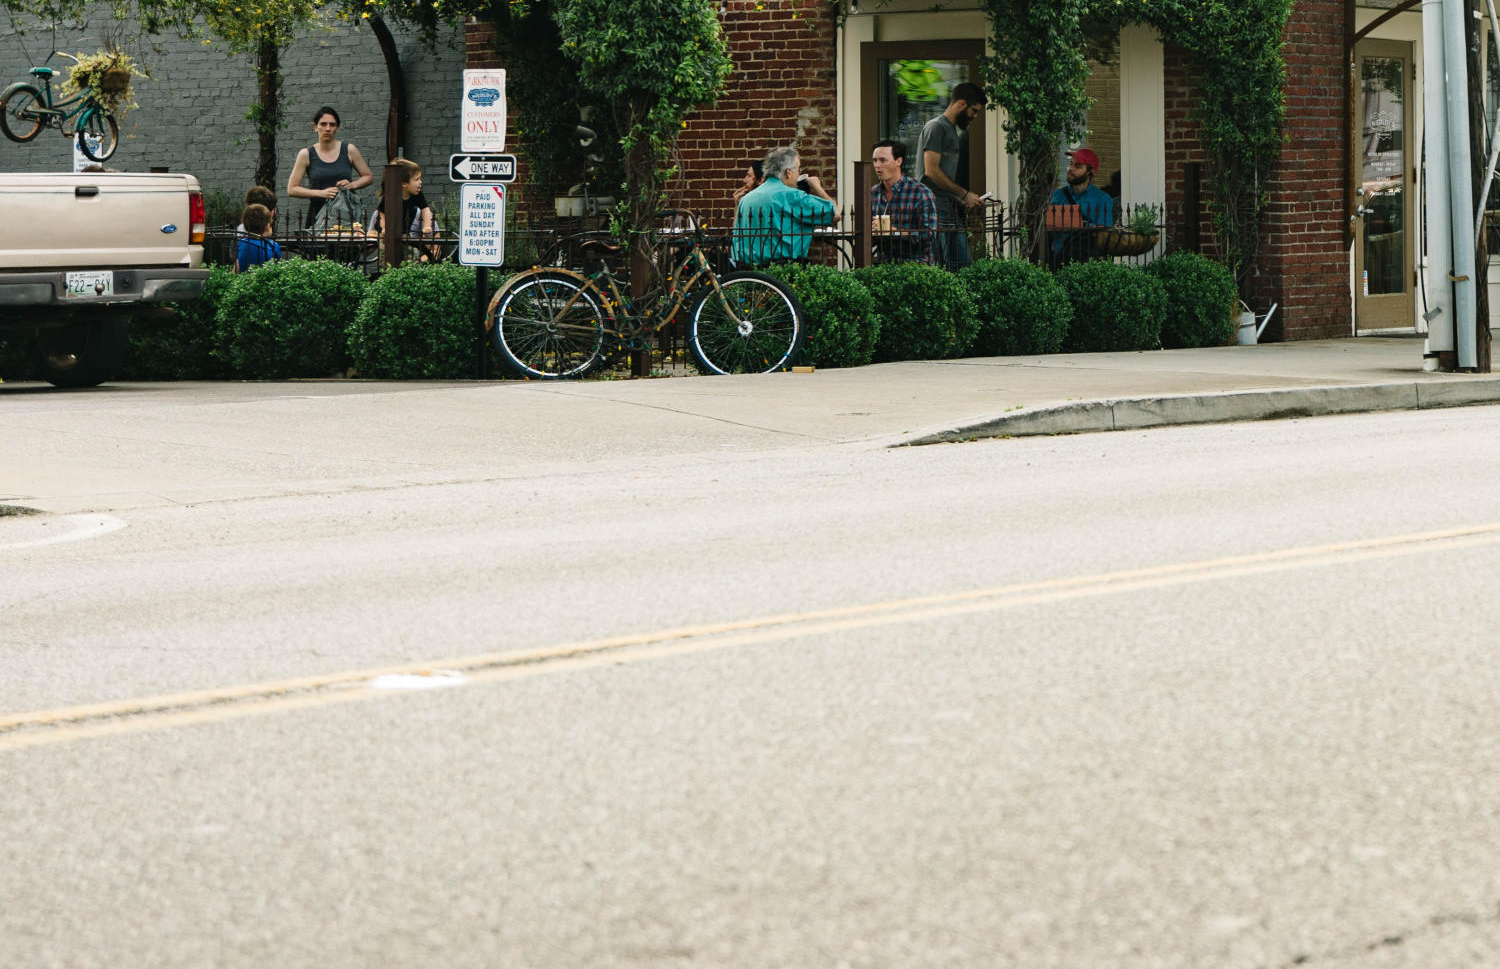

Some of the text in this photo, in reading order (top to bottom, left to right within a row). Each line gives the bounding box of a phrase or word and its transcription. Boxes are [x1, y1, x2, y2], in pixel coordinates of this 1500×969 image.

[467, 120, 500, 134] ONLY
[470, 162, 510, 173] ONE WAY
[468, 202, 496, 210] PARKING
[469, 211, 495, 219] ALL DAY
[469, 220, 495, 228] SUNDAY
[464, 229, 500, 237] AND AFTER
[469, 239, 494, 247] 6:00PM
[465, 248, 481, 256] MON
[485, 248, 497, 256] SAT
